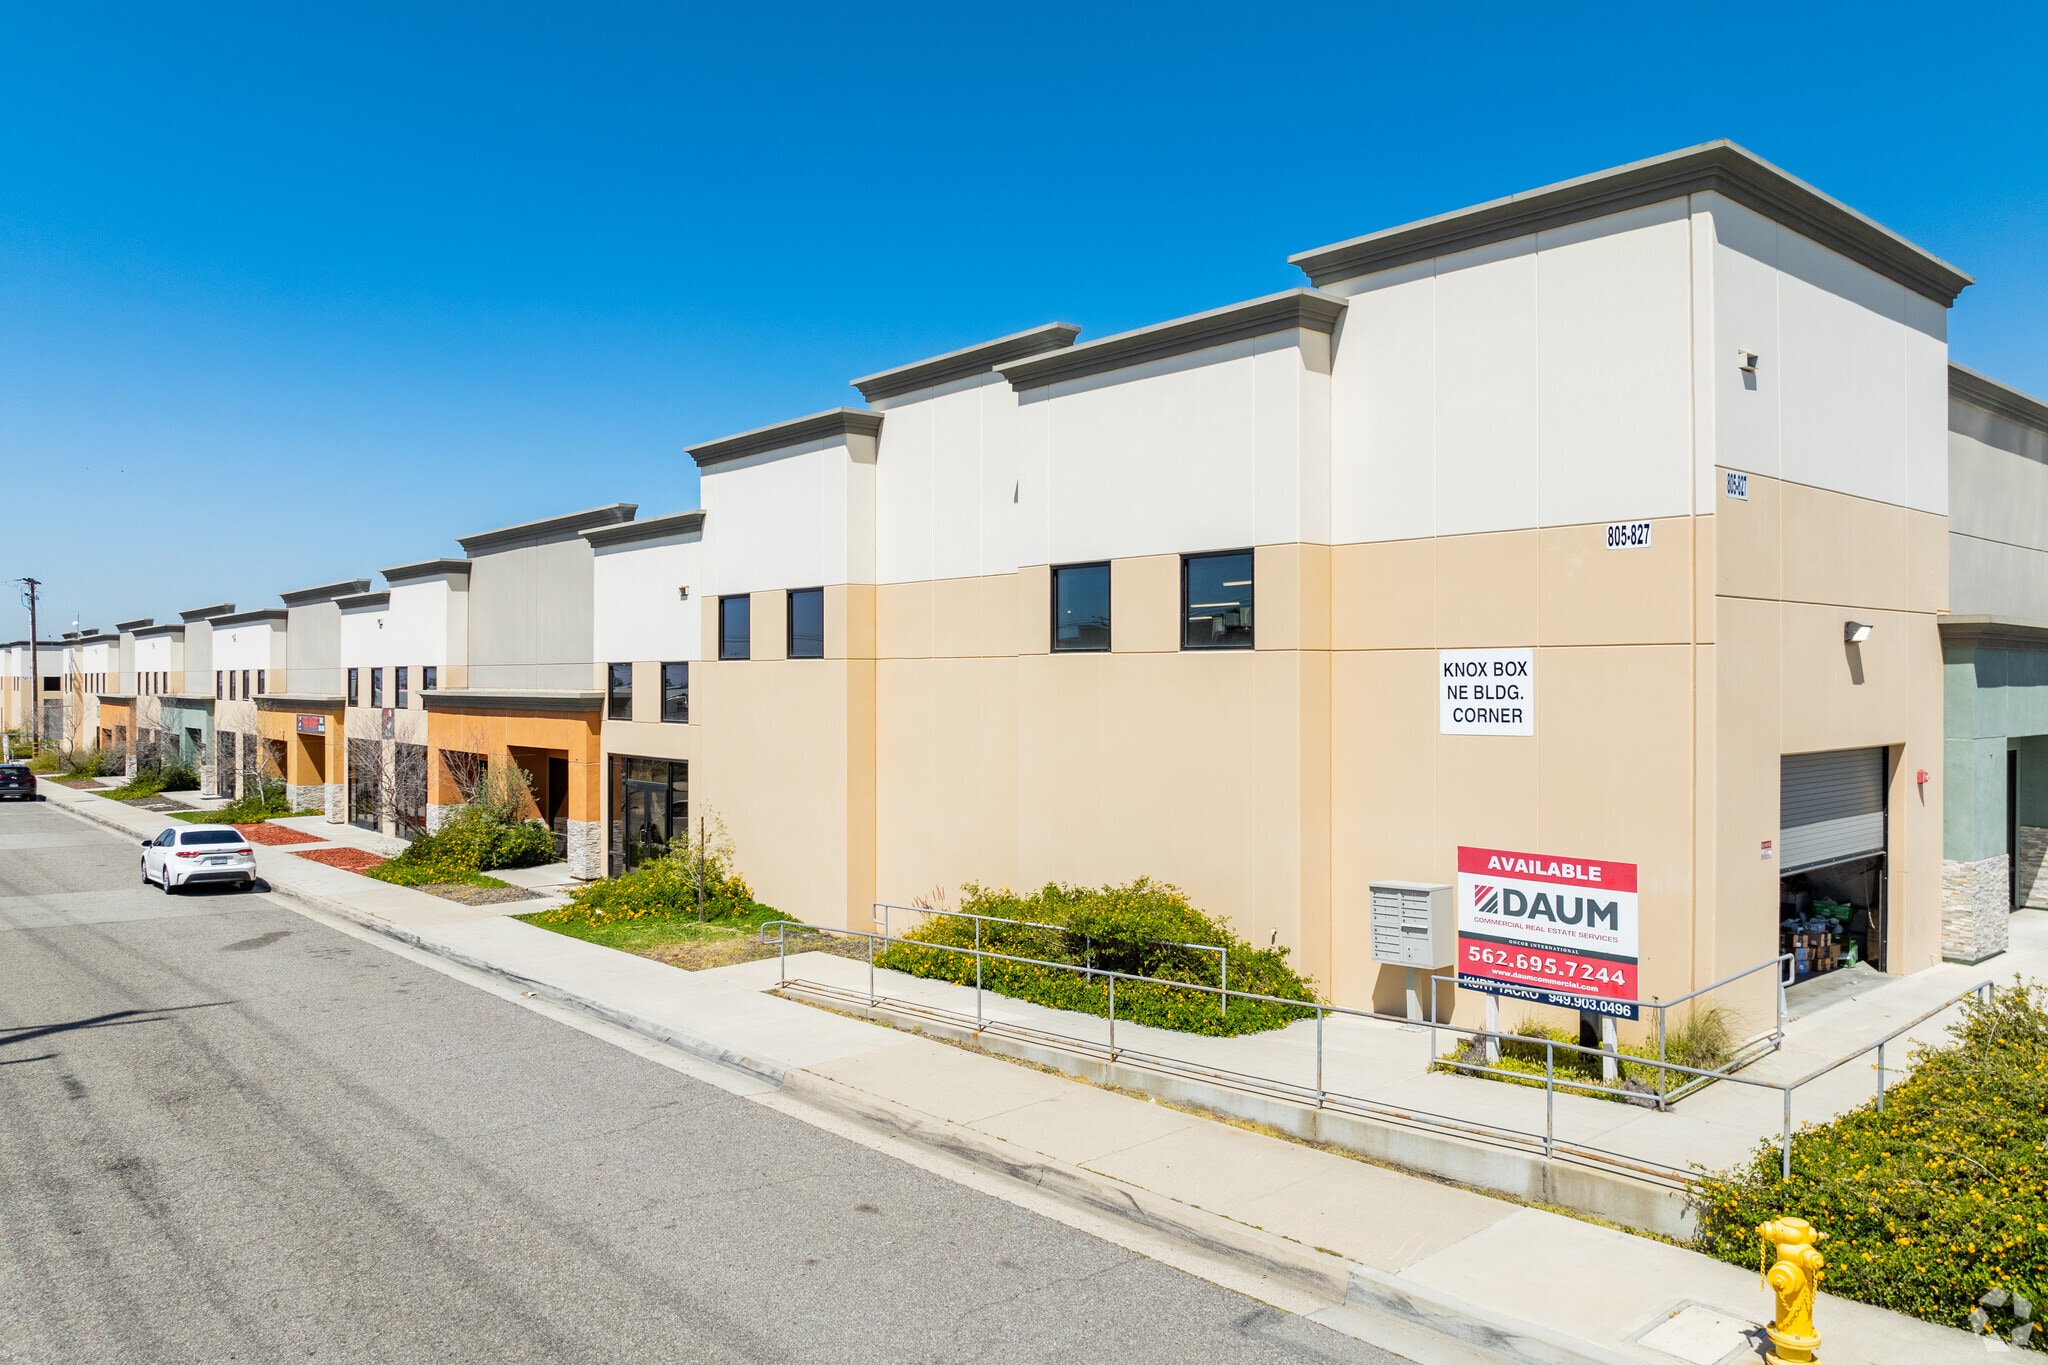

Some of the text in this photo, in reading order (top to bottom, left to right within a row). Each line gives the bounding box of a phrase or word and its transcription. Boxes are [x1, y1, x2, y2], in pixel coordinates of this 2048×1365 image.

[1608, 523, 1650, 547] 805-827
[1443, 661, 1528, 677] KNOX BOX
[1447, 684, 1524, 700] NE BLDG.
[1453, 707, 1523, 723] CORNER
[1488, 856, 1601, 881] AVAILABLE
[1503, 888, 1618, 931] DAUM
[1474, 916, 1618, 943] COMMERCIAL REAL ESTATE SERVICES
[1508, 939, 1579, 955] ONCOR INTERNATIONAL
[1468, 946, 1626, 986] 562.695.7244
[1491, 968, 1599, 993] www.daumcommercial.com
[1548, 993, 1632, 1017] 949.903.0496
